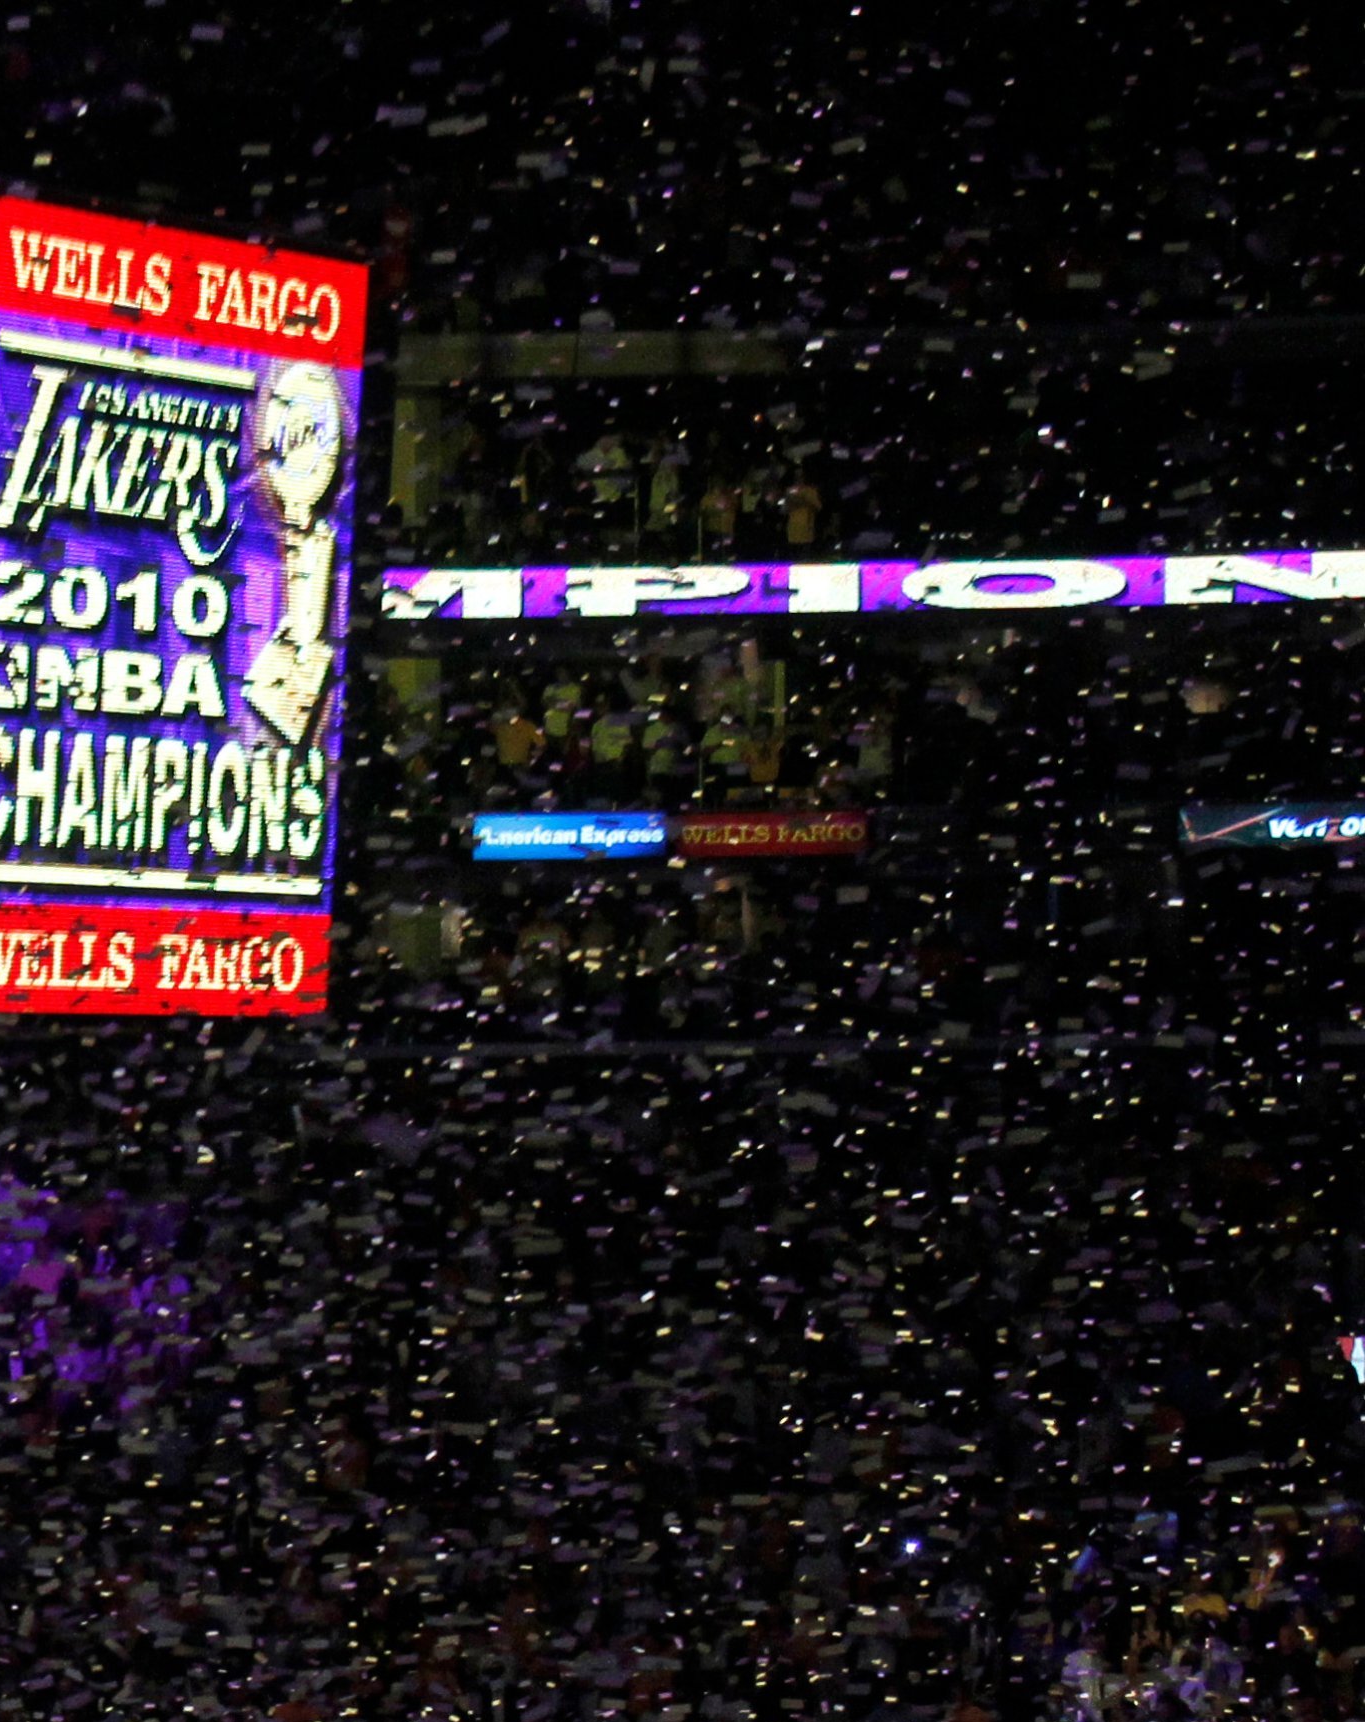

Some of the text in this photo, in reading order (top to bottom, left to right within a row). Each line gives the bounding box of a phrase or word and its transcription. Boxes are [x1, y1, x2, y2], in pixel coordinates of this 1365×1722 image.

[9, 226, 341, 342] WELLS FARGO
[35, 644, 226, 717] NBA
[580, 824, 665, 848] Express
[681, 822, 866, 845] WELLS FARGO
[1269, 814, 1365, 843] verizo
[156, 933, 305, 993] FARGO
